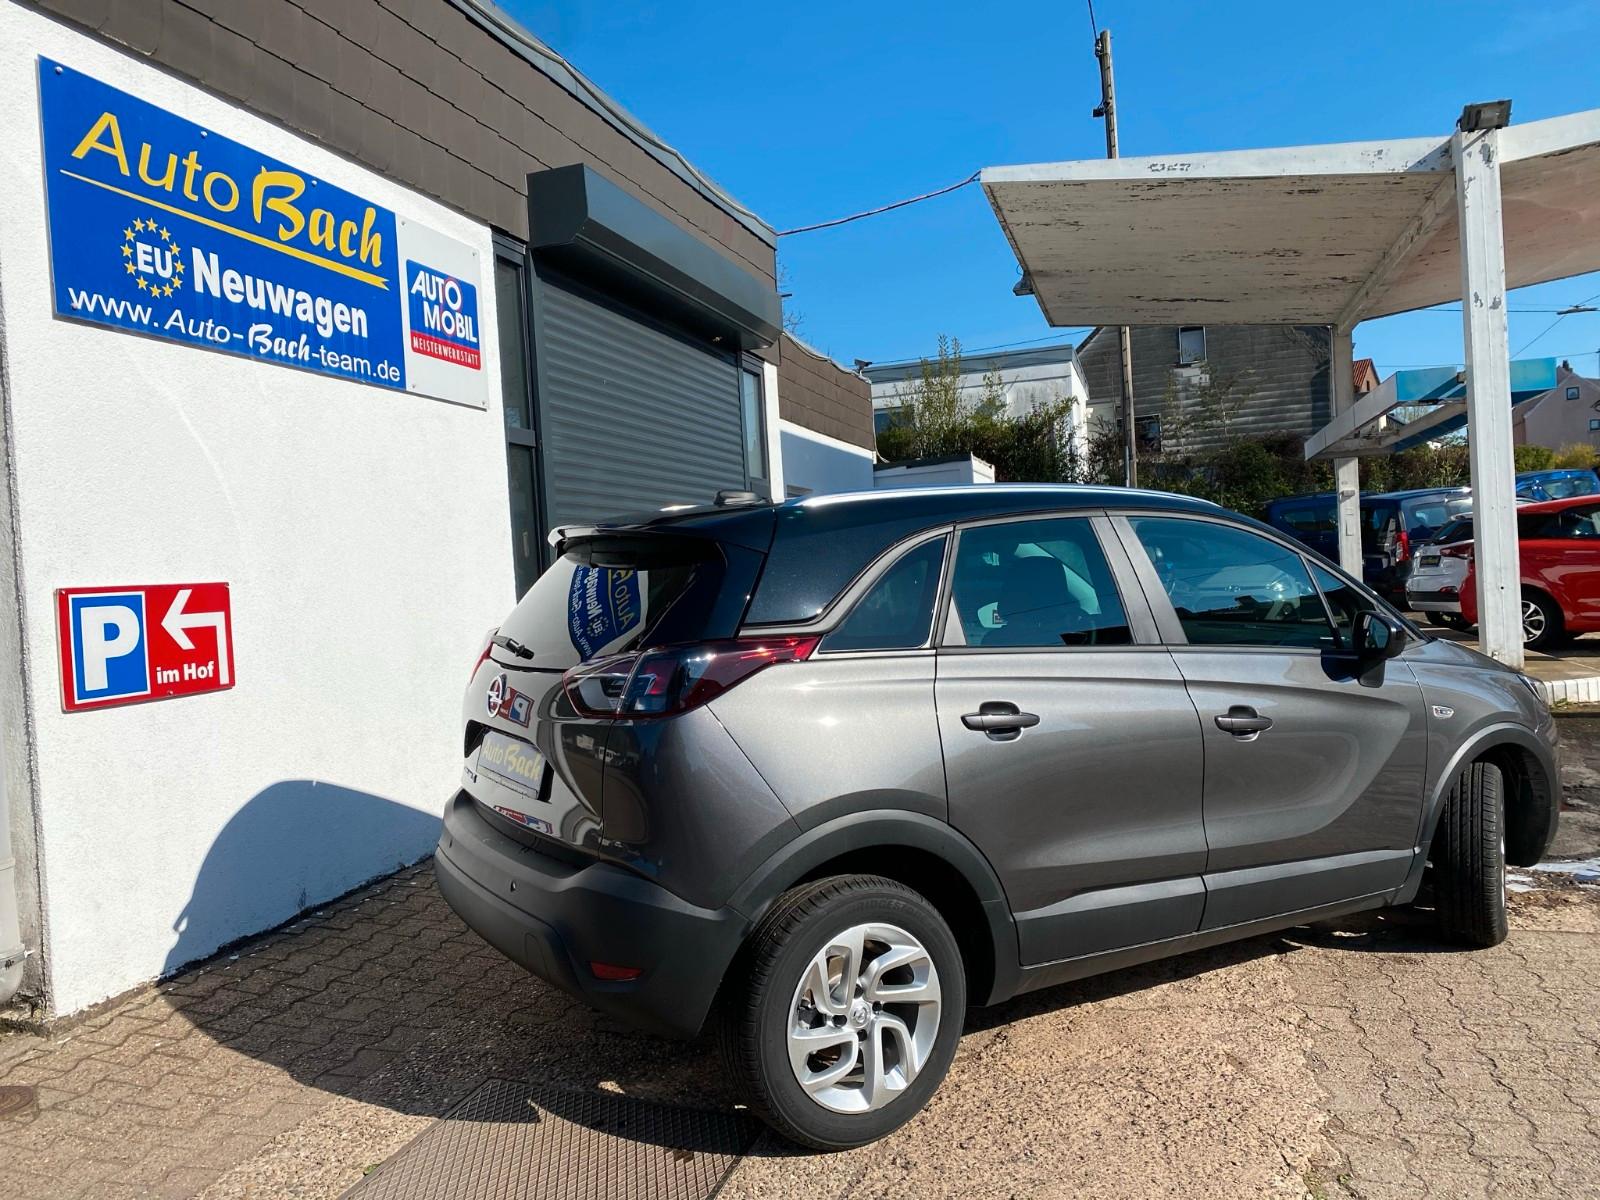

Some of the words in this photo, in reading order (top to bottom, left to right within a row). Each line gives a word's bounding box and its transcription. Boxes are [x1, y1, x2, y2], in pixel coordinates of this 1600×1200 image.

[72, 111, 239, 212] Auto
[253, 166, 382, 267] Bach
[136, 244, 172, 278] EU
[192, 247, 368, 339] Neuwagen
[411, 270, 462, 311] AUTO
[423, 301, 478, 343] MOBIL
[413, 336, 479, 366] MEISTERWERKSTATT
[80, 605, 140, 692] P
[156, 667, 180, 685] im
[183, 661, 215, 681] Hof
[482, 739, 504, 765] Auto
[504, 744, 541, 781] Bach
